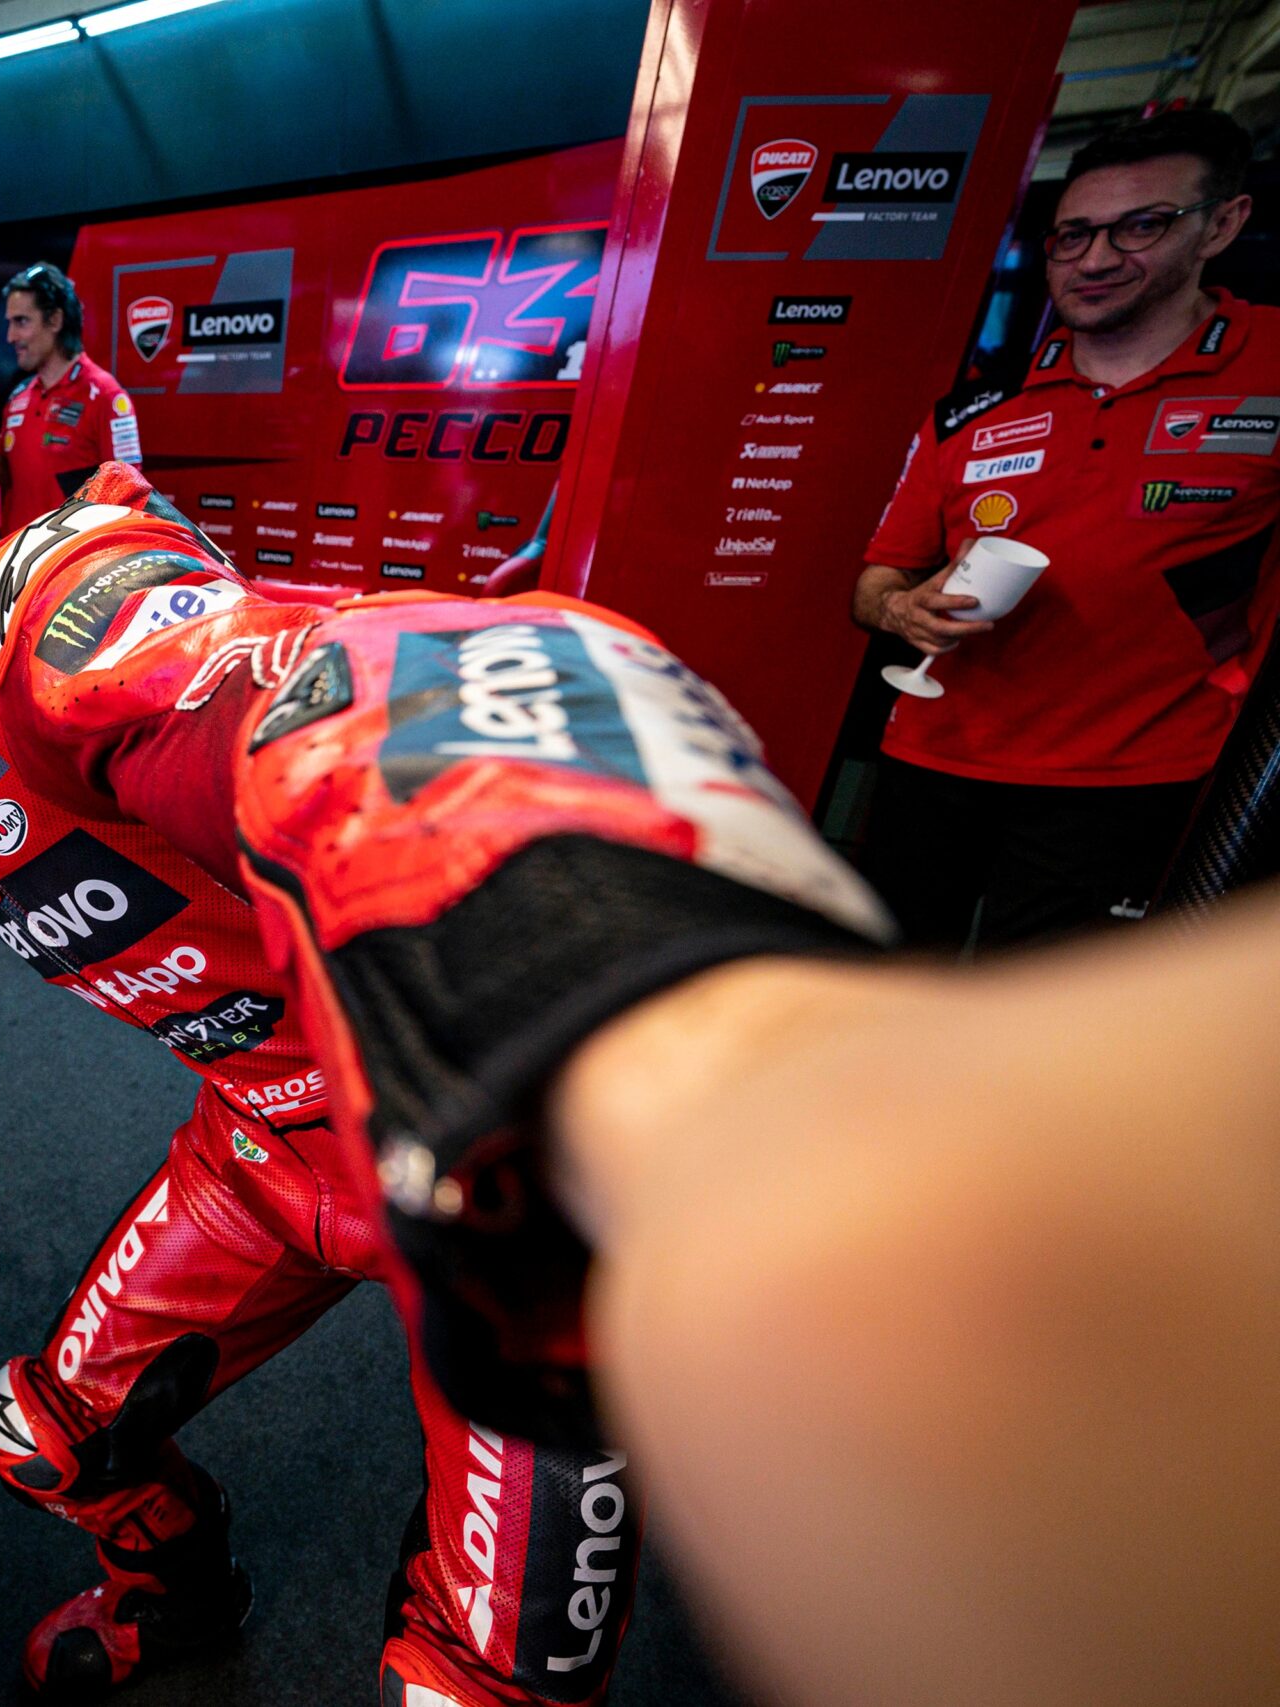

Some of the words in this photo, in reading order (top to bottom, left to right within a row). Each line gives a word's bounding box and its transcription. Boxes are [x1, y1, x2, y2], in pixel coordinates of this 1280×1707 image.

[758, 152, 811, 165] DUCATI
[836, 163, 949, 190] Lenovo
[867, 213, 907, 221] FACTORY
[911, 212, 937, 221] TEAM
[775, 302, 843, 319] Lenovo
[189, 313, 274, 337] Lenovo
[756, 414, 781, 424] Audi
[783, 414, 815, 425] Sport
[1213, 417, 1275, 429] Lenovo
[337, 411, 575, 463] PECCO
[988, 452, 1036, 475] riello
[746, 478, 792, 490] NetApp
[319, 506, 356, 518] Lenovo
[383, 565, 423, 578] Lenovo
[158, 997, 268, 1048] NSTER
[57, 1223, 146, 1382] DAIKO
[547, 1450, 628, 1673] Lenov
